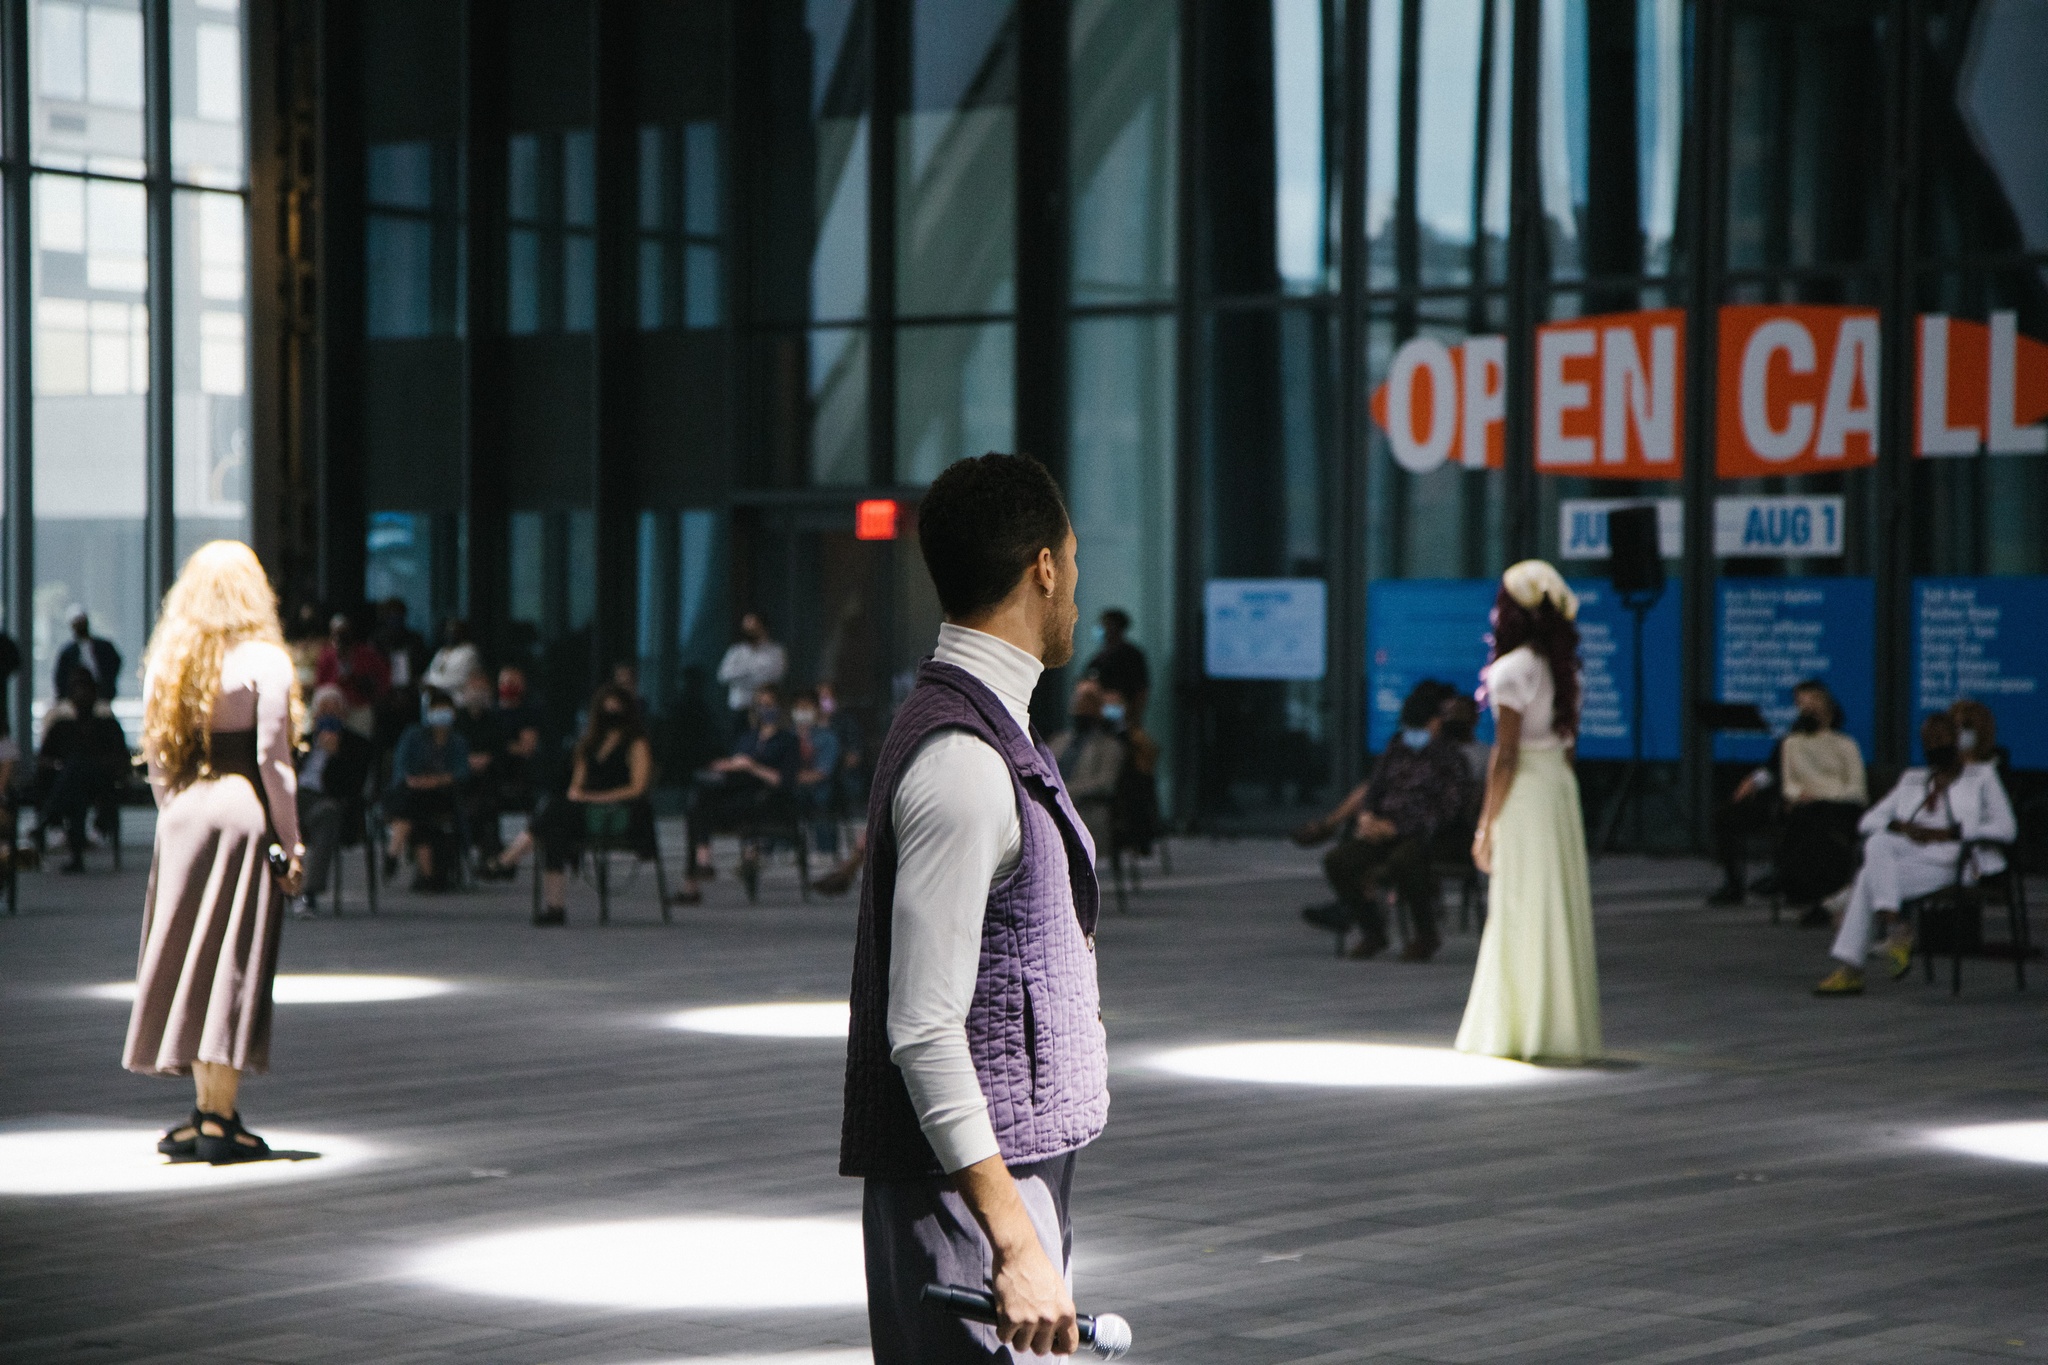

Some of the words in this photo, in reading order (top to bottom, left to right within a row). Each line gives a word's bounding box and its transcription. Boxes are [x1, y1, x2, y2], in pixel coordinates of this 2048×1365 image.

[1387, 325, 1679, 475] OPEN
[1739, 310, 2048, 463] CALL
[1570, 510, 1610, 550] JU
[1743, 505, 1812, 546] AUG
[1822, 504, 1836, 545] 1
